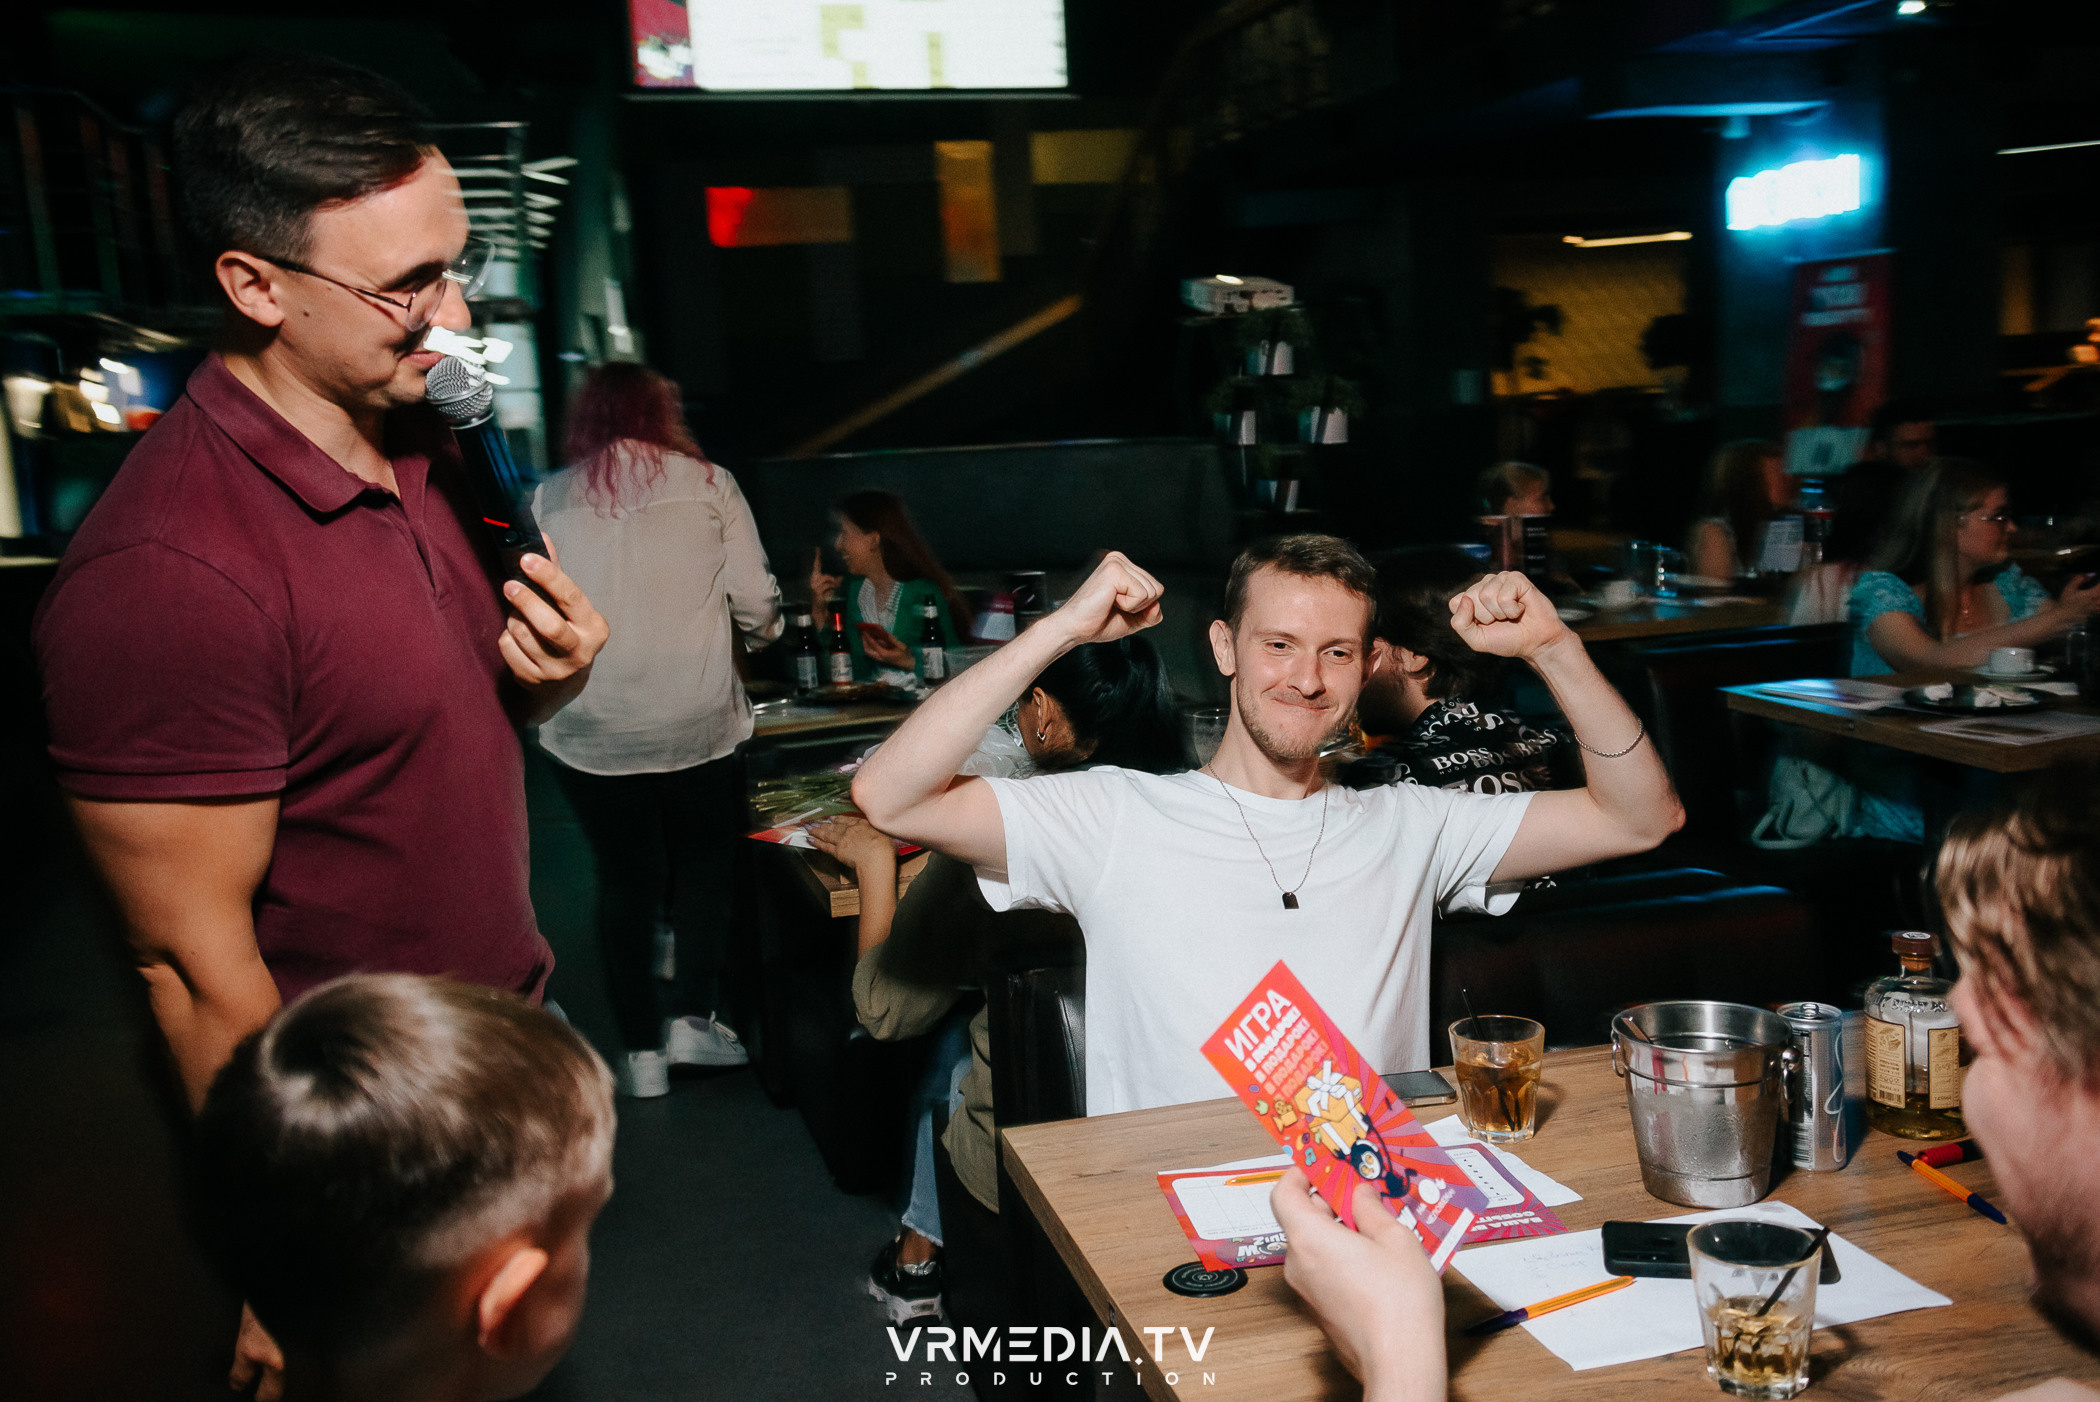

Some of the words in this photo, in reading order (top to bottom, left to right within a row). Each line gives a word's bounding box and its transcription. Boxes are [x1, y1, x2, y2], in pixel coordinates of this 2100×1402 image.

[1432, 747, 1493, 770] BOSS
[1440, 764, 1467, 775] HUGO
[1224, 989, 1292, 1062] ИГРА
[1252, 1005, 1301, 1063] ПОДАРОК!
[1262, 1017, 1311, 1075] ПОДАРОК!
[1271, 1028, 1320, 1087] ПОДАРОК!
[1281, 1040, 1330, 1098] ПОДАРОК!
[1476, 1211, 1535, 1224] СОБЫТ
